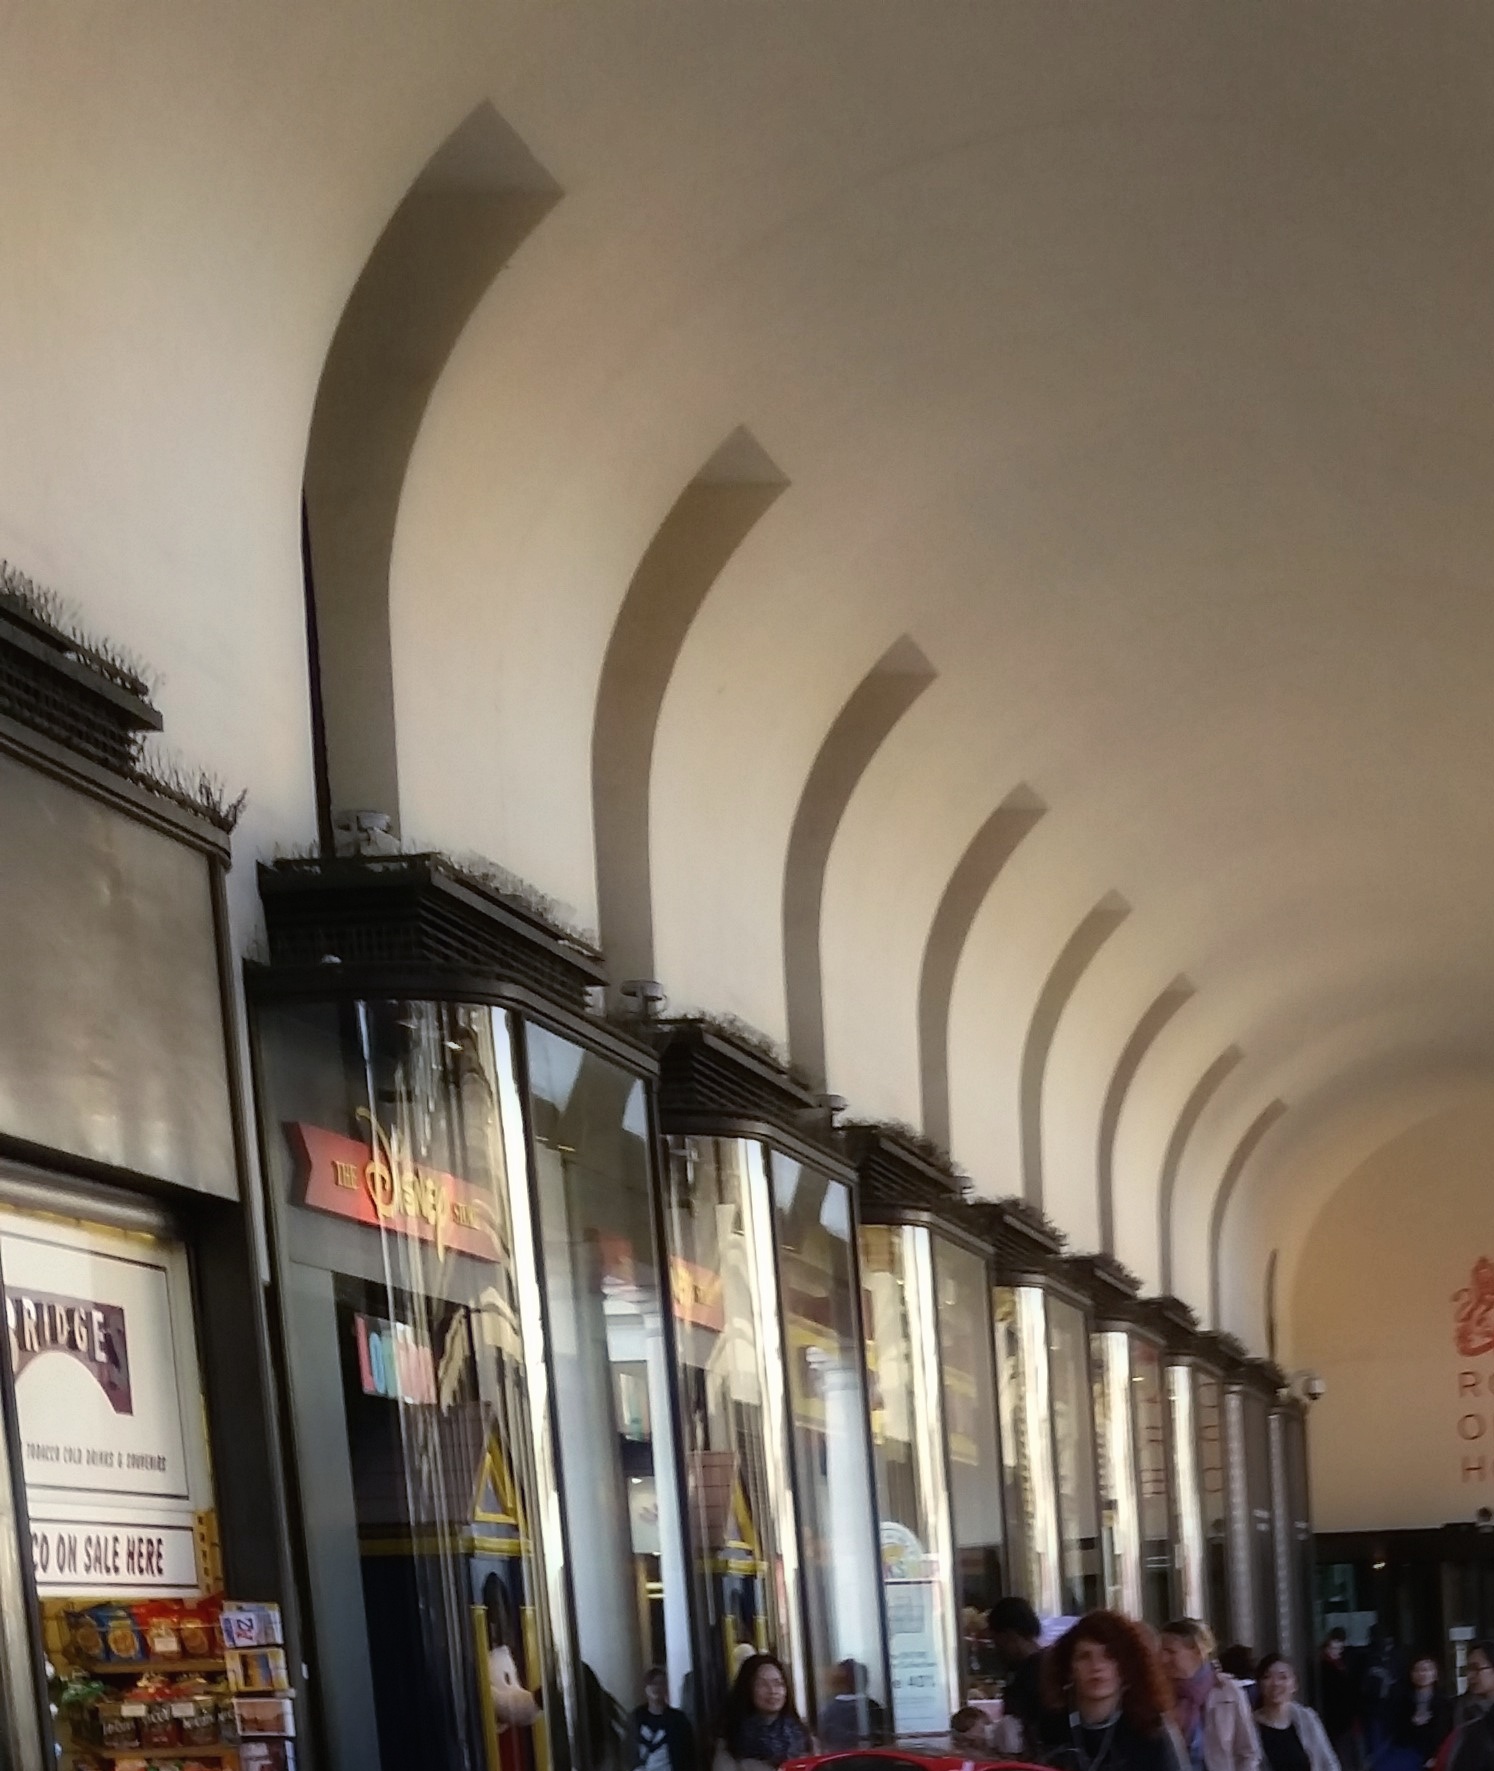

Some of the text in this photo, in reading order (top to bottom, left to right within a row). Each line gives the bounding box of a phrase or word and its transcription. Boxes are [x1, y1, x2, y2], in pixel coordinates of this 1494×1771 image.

[333, 1161, 359, 1190] THE
[63, 1446, 82, 1466] COLD
[56, 1533, 78, 1574] ON
[84, 1534, 120, 1576] SALE
[127, 1534, 164, 1577] HERE
